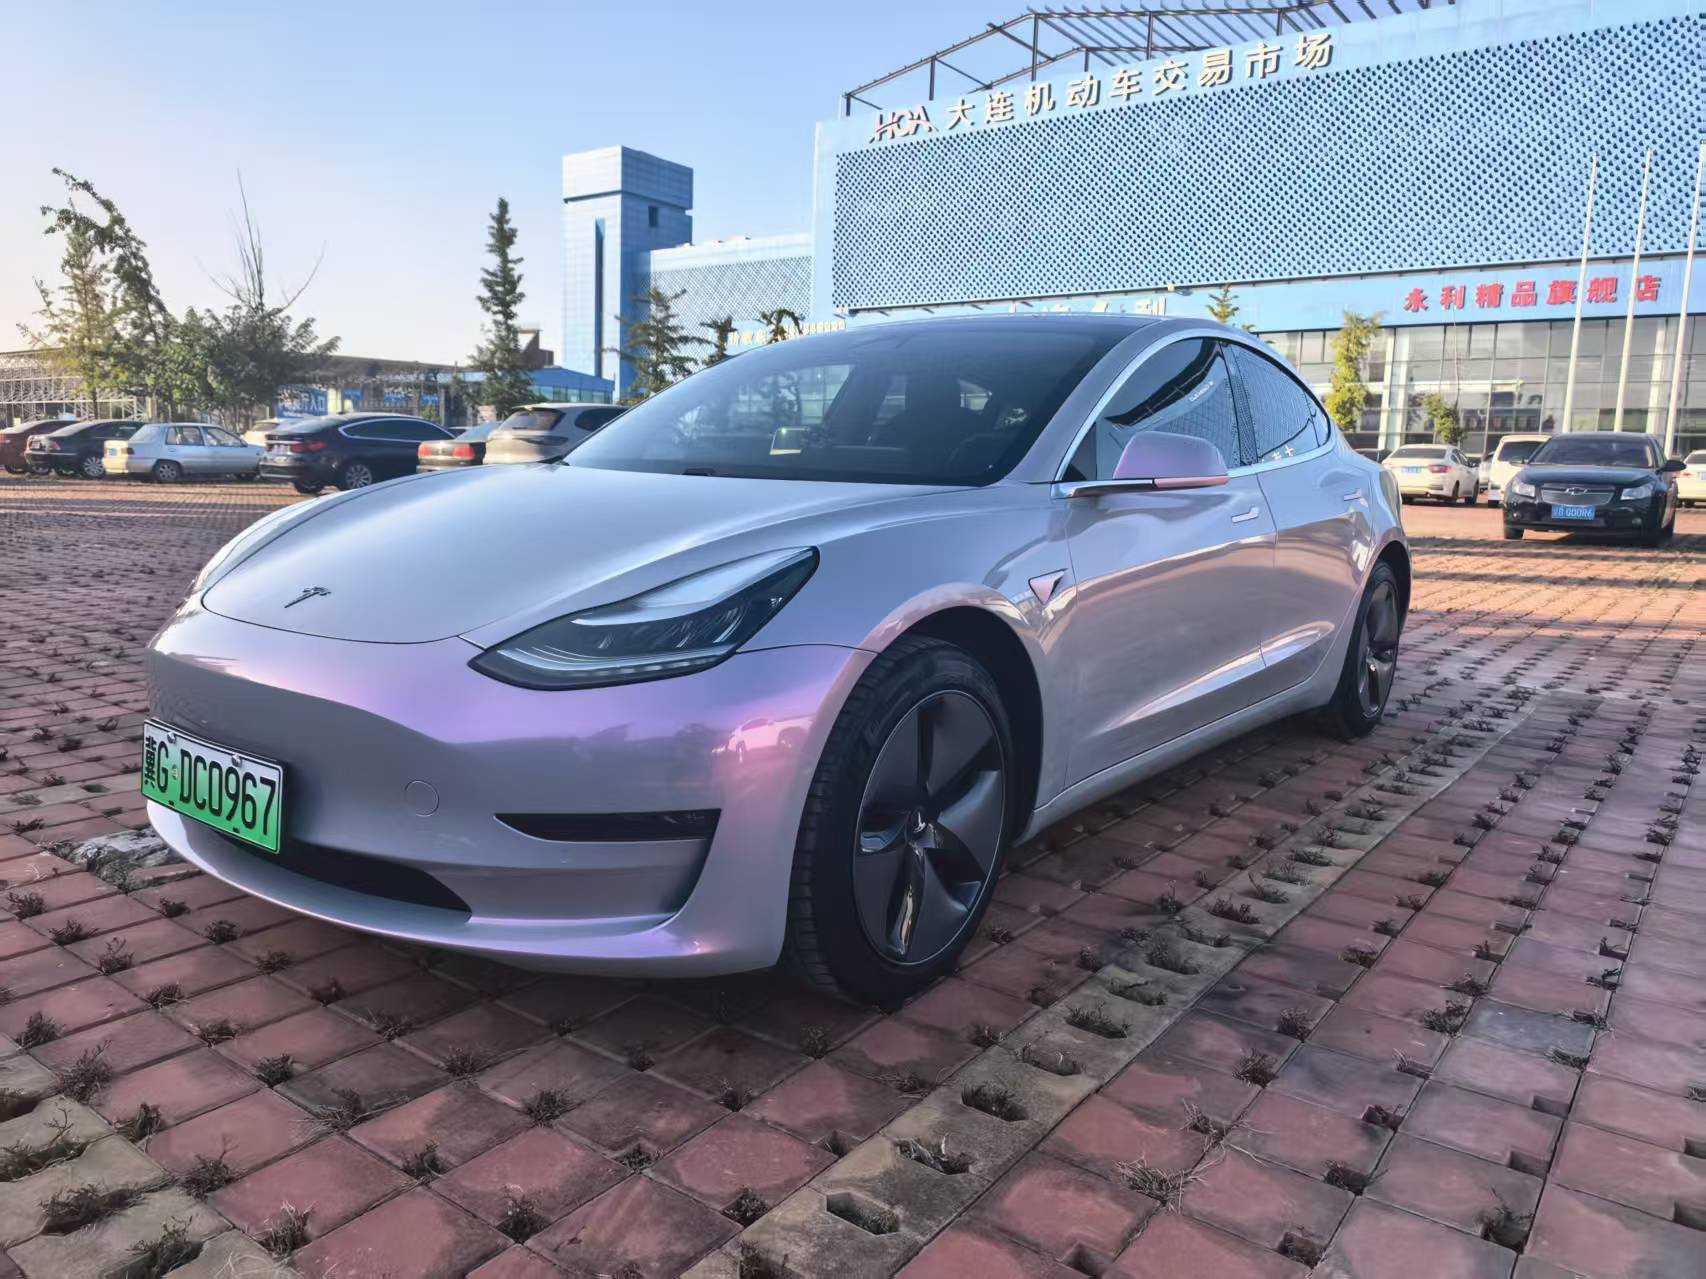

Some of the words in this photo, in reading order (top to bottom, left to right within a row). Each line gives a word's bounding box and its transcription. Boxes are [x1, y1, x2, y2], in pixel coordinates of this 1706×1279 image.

[947, 32, 1334, 131] 大连机动车交易市场
[1403, 275, 1662, 312] 永利精品旗舰店
